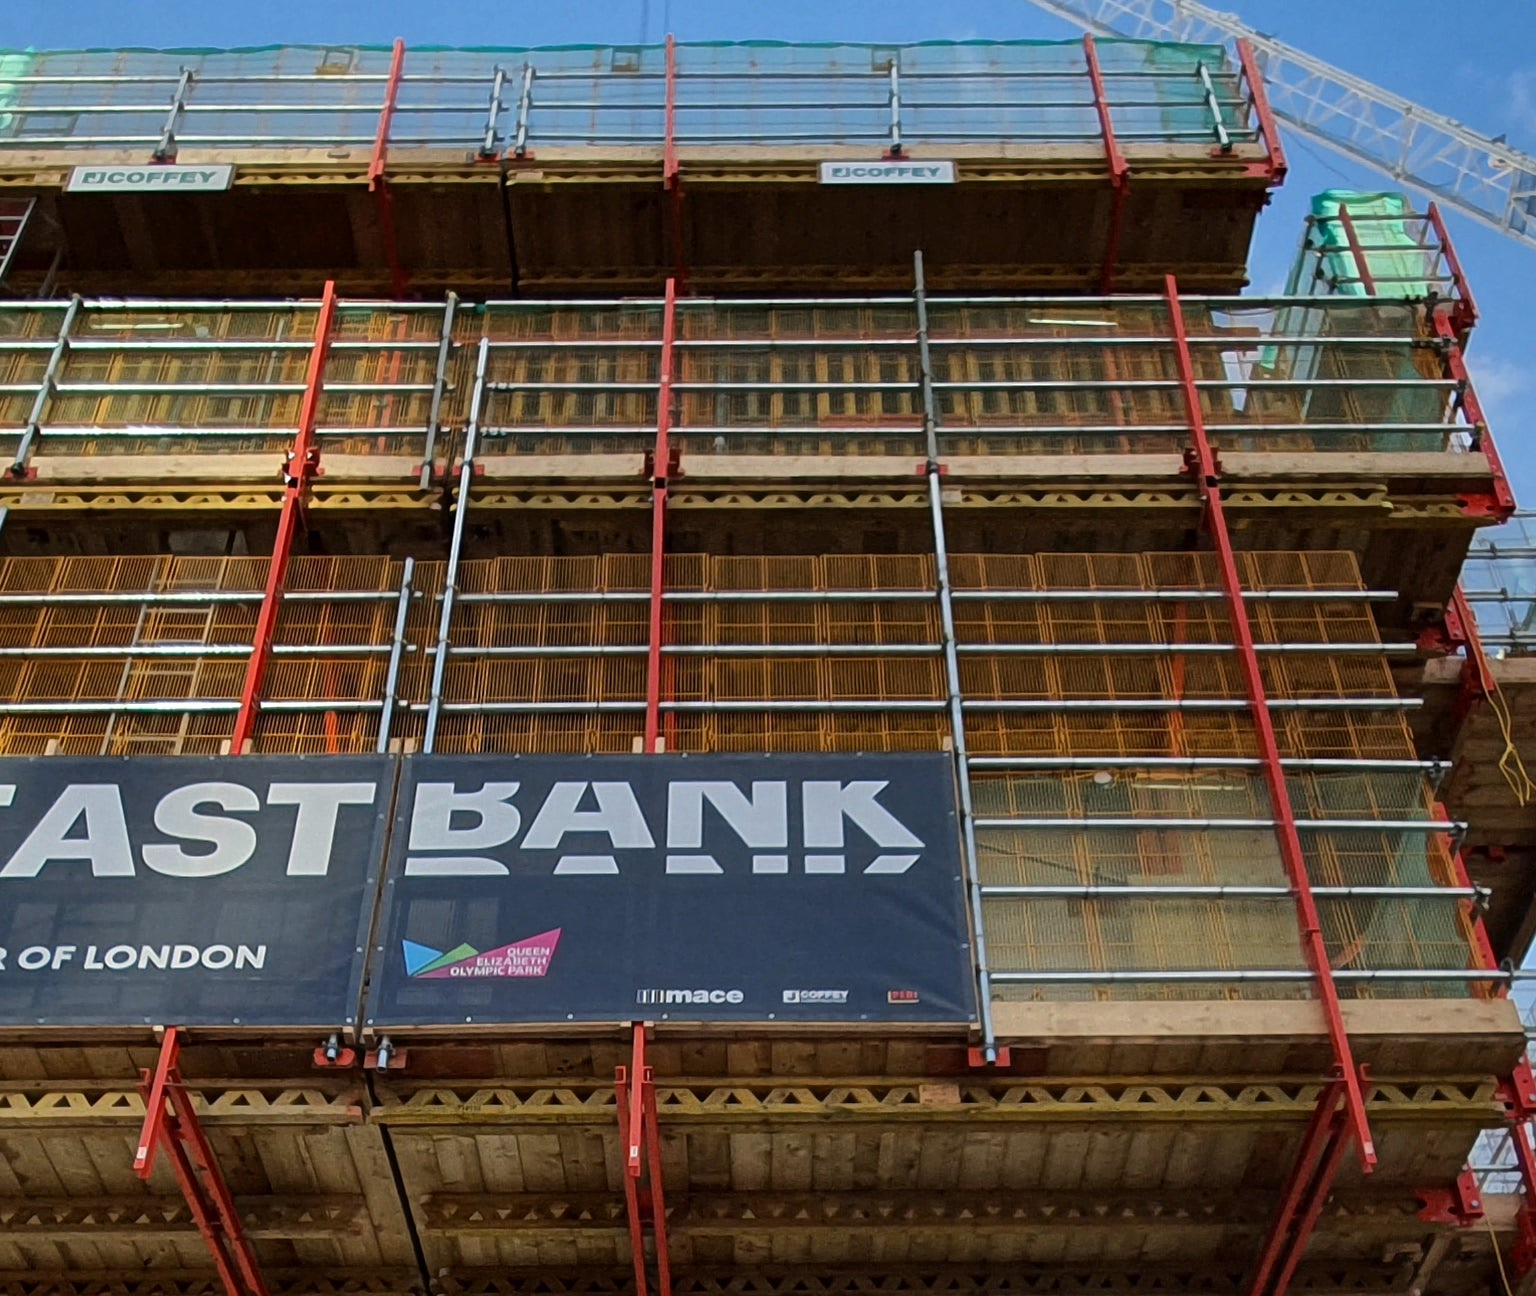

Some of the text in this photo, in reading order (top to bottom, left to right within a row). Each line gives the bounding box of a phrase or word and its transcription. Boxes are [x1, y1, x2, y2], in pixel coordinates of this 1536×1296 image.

[404, 781, 926, 876] BANK
[17, 946, 76, 970] OF
[83, 944, 266, 969] LONDON
[507, 947, 550, 957] QUEEN
[476, 957, 547, 966] ELIZABETH
[450, 965, 542, 976] OLYMPIC PARK
[665, 990, 744, 1003] mace
